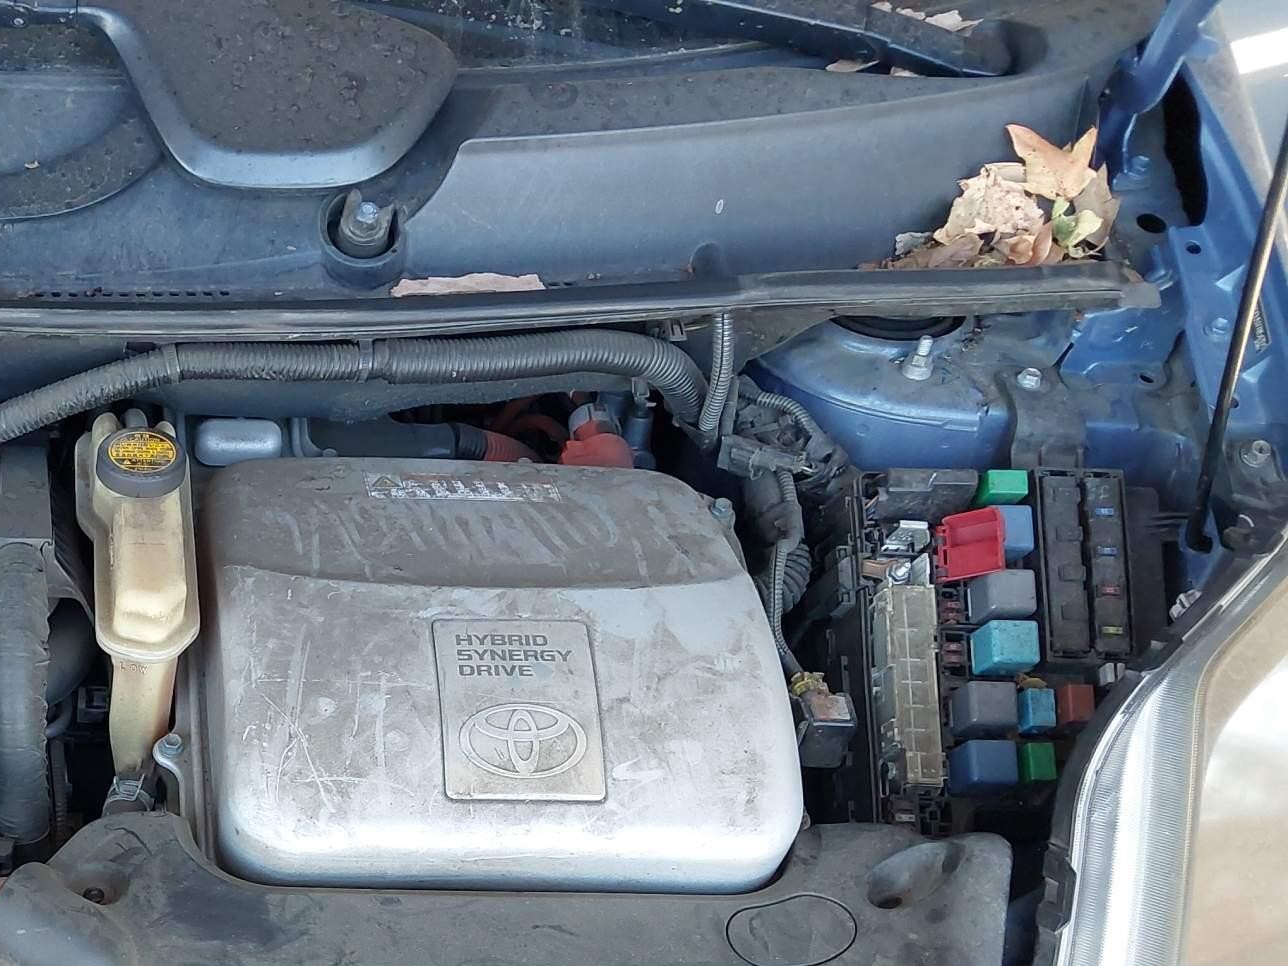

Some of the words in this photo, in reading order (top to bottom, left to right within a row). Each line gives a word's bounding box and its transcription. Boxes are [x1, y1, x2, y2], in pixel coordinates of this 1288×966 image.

[455, 634, 548, 647] HYBRID
[456, 649, 572, 662] SYNERGY
[458, 664, 534, 677] DRIVE
